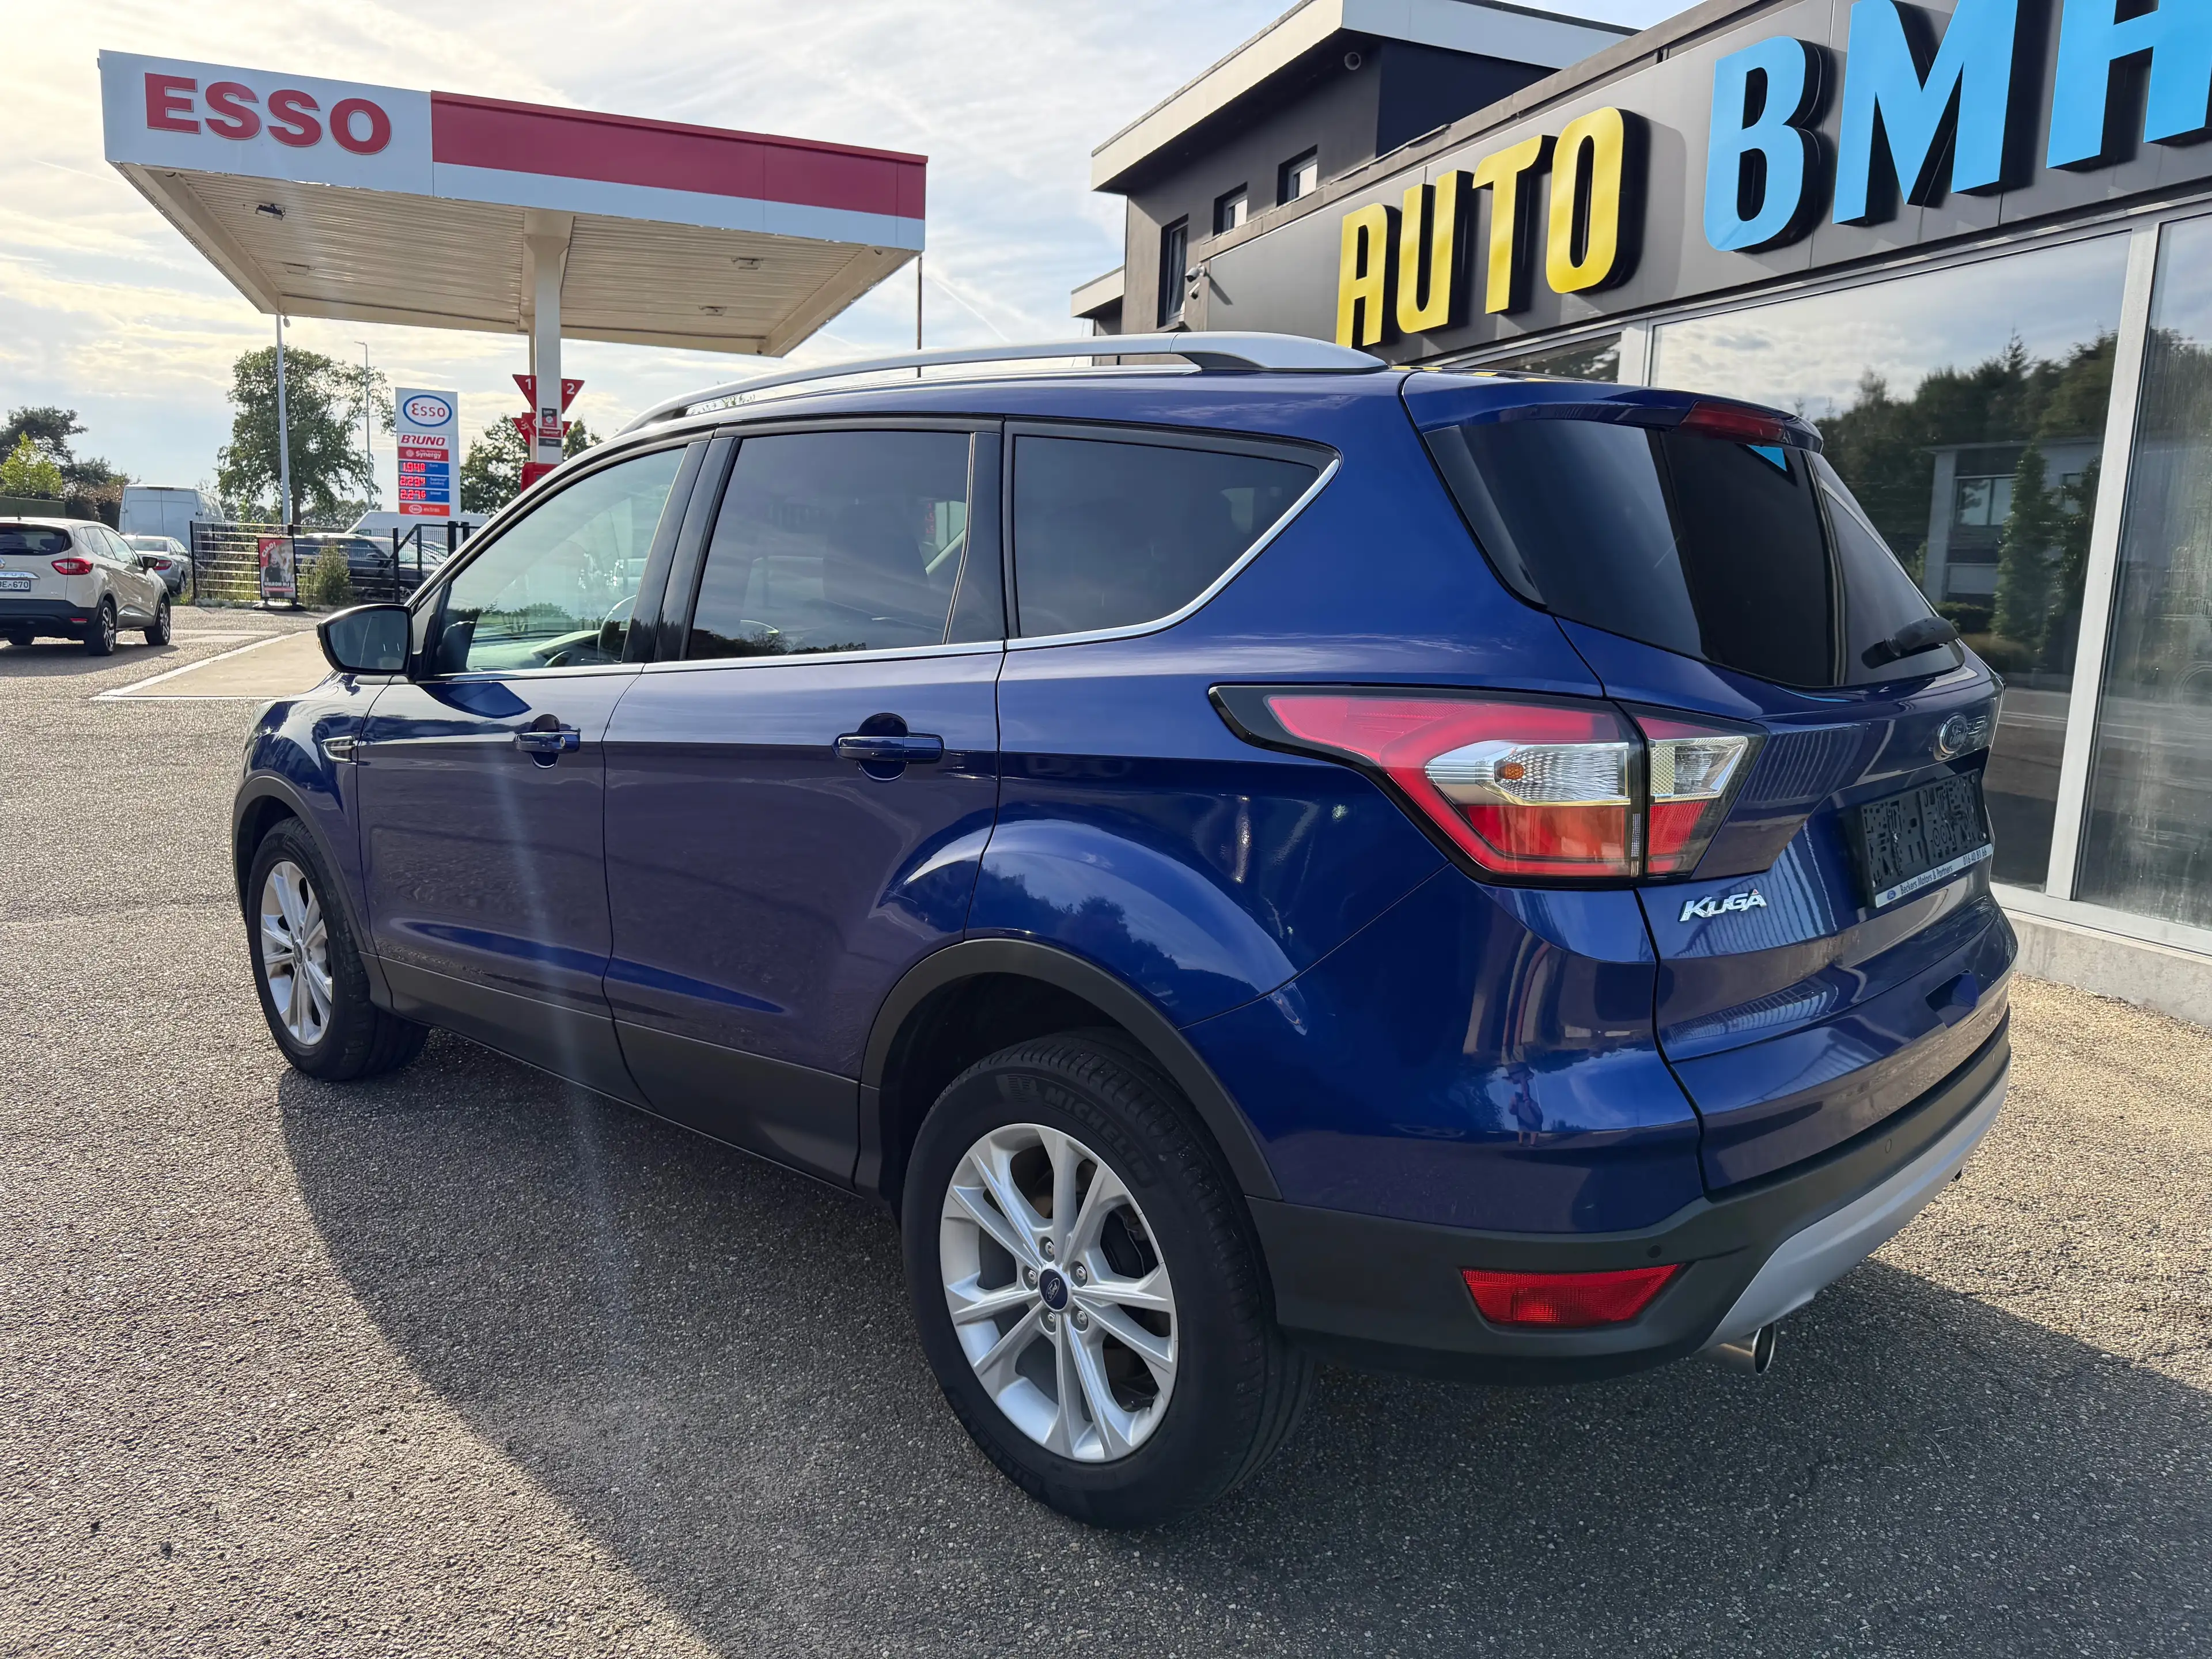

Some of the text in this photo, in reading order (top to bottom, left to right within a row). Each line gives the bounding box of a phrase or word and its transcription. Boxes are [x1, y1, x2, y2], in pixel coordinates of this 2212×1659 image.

[144, 72, 392, 156] ESSO
[1336, 107, 1626, 349] AUTO
[525, 378, 531, 390] 1
[566, 383, 575, 395] 2
[400, 434, 446, 446] BRUNO
[415, 450, 442, 460] Synergy
[1900, 881, 1918, 895] Beckers
[1917, 875, 1933, 887] Motors
[1932, 870, 1937, 880] &
[1936, 866, 1953, 878] Partners
[1679, 889, 1767, 922] KUGA
[1044, 1086, 1155, 1181] MICHELIN
